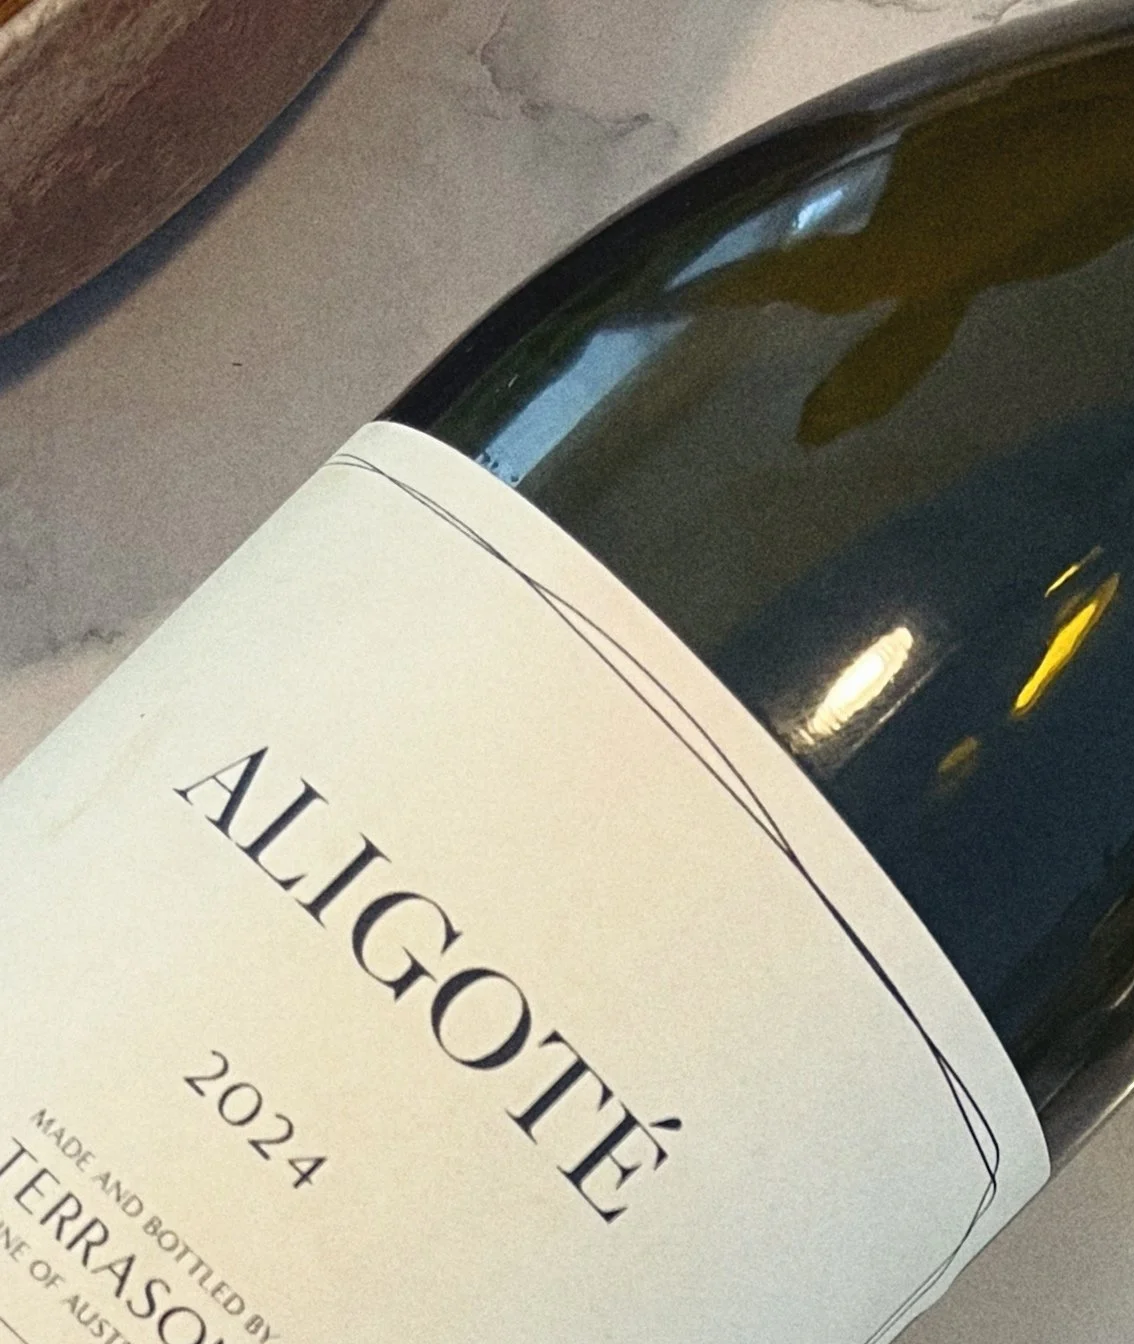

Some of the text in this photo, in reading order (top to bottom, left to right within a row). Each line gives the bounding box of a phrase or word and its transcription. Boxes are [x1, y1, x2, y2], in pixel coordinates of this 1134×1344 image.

[173, 745, 683, 1224] ALIGOTÉ
[183, 1050, 328, 1190] 2024
[28, 1259, 66, 1290] OF
[30, 1107, 96, 1172] MADE
[91, 1171, 144, 1218] AND
[143, 1215, 246, 1316] BOTTLED
